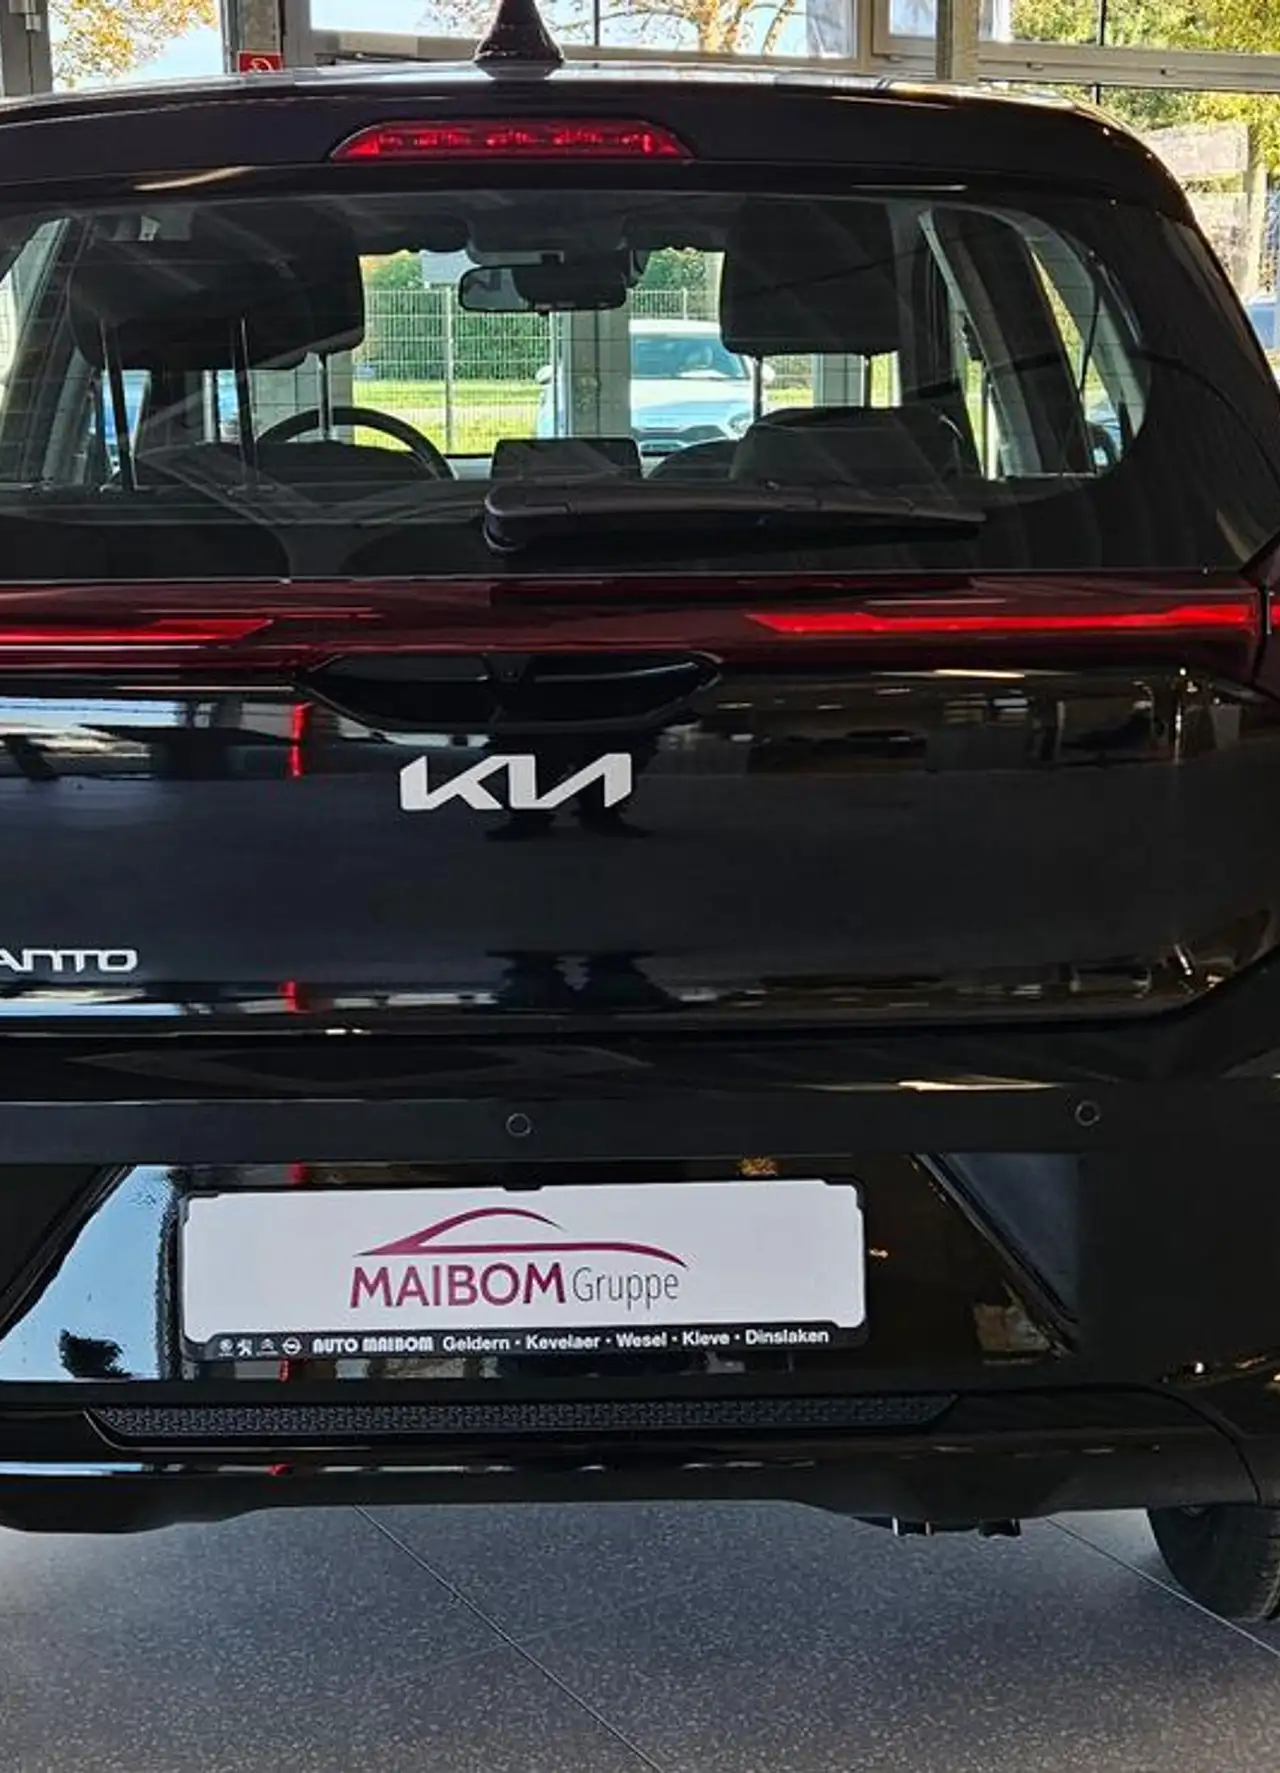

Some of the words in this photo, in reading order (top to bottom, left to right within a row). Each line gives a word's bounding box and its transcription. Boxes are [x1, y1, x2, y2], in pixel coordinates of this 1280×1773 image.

[399, 752, 634, 811] KIA
[350, 1262, 567, 1308] MAIBOM
[572, 1266, 680, 1310] Gruppe
[312, 1337, 358, 1353] AUTO
[362, 1336, 433, 1352] MAIBOM
[442, 1335, 510, 1351] Geldern
[525, 1333, 600, 1349] Kevelaer
[616, 1331, 668, 1347] Wesel
[682, 1330, 730, 1345] Kleve
[745, 1328, 829, 1345] Dinslaken
